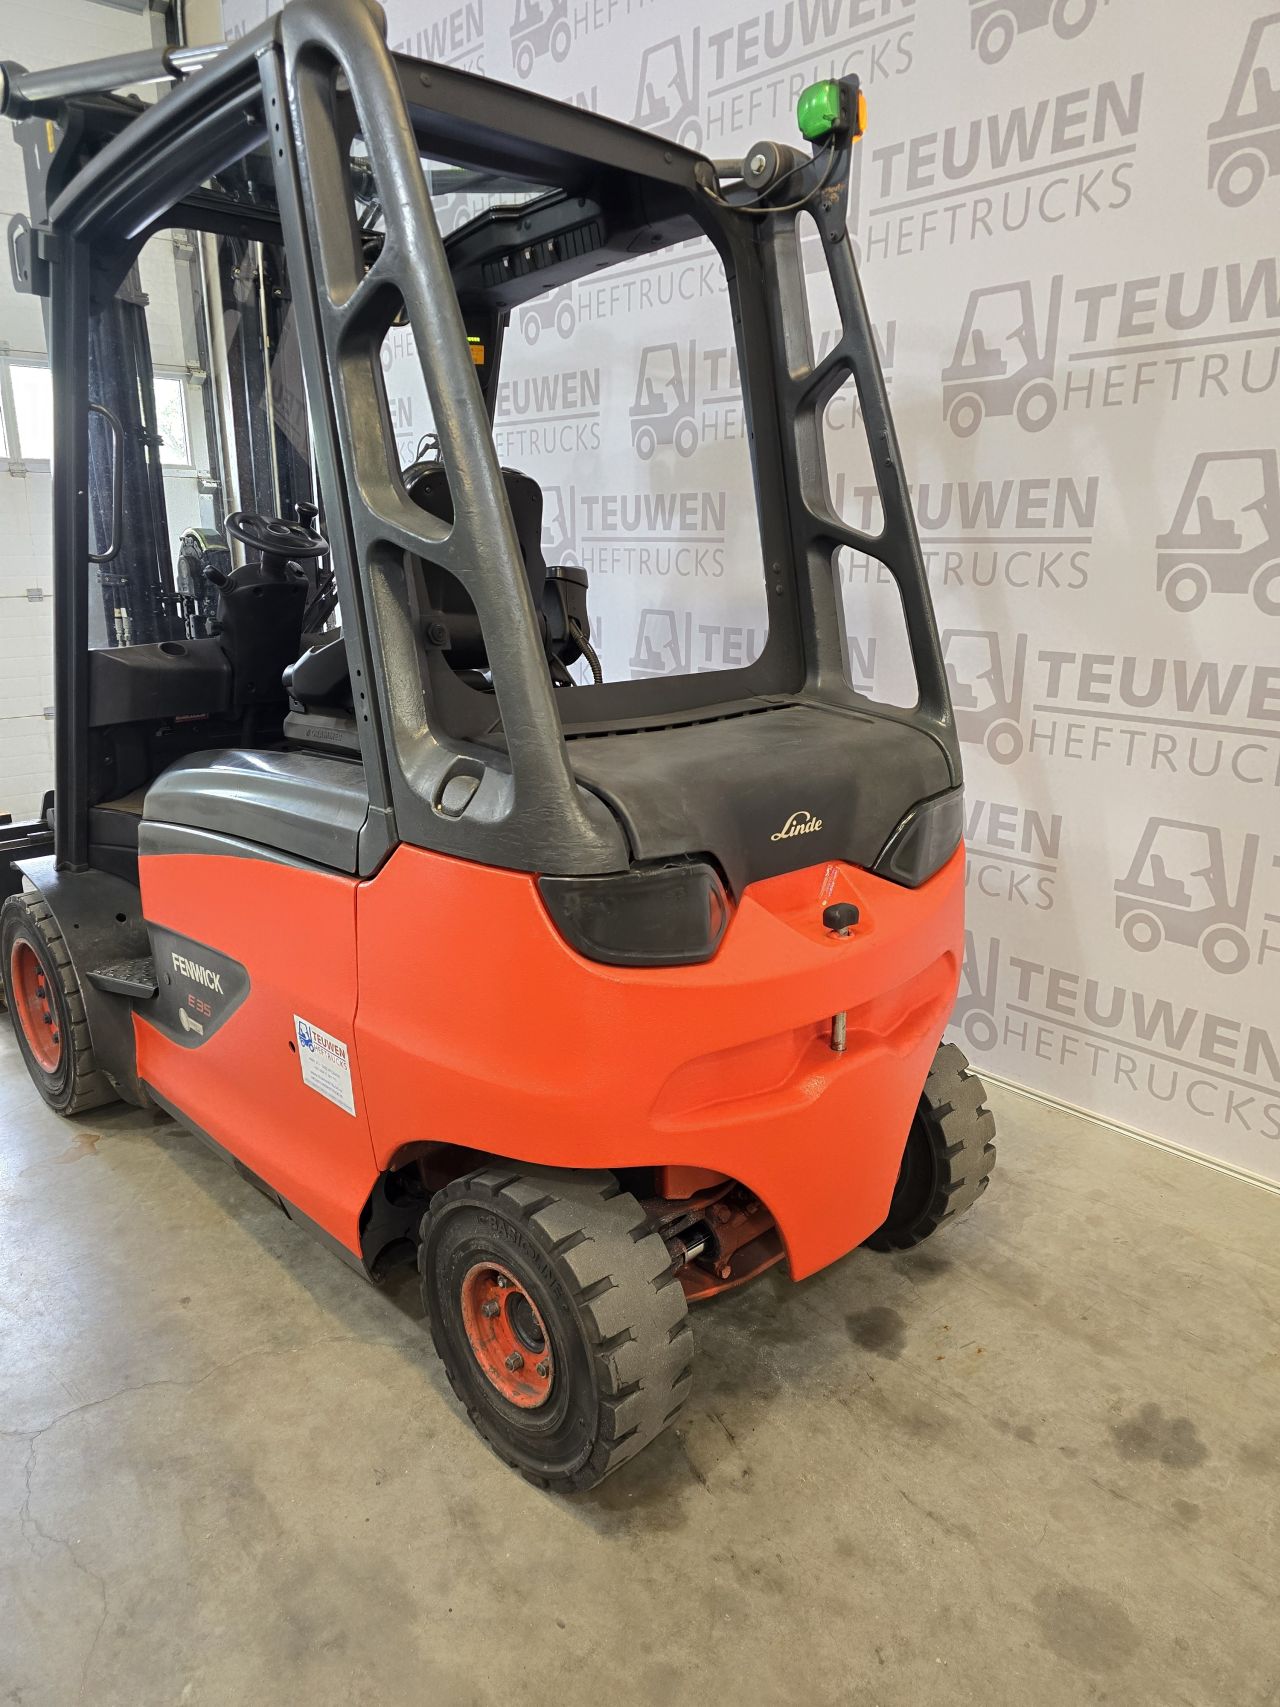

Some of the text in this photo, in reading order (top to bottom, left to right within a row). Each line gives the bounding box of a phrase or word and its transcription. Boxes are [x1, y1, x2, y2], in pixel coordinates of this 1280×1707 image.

[708, 0, 916, 80] TEUWE
[871, 72, 1145, 200] TEUWEN
[866, 162, 1134, 263] HEFTRUCKS
[497, 368, 600, 417] EUWEN
[495, 422, 600, 457] EFTRUCKS
[581, 491, 726, 531] TEUWEN
[854, 476, 1100, 530] TUWEN
[581, 547, 724, 577] HEFTRUCKS
[849, 550, 1091, 589] HETRUCKS
[1028, 719, 1280, 788] HEFTRUC
[770, 810, 823, 841] Linde
[172, 952, 224, 995] FENWICK
[312, 1030, 346, 1060] TEUWEN
